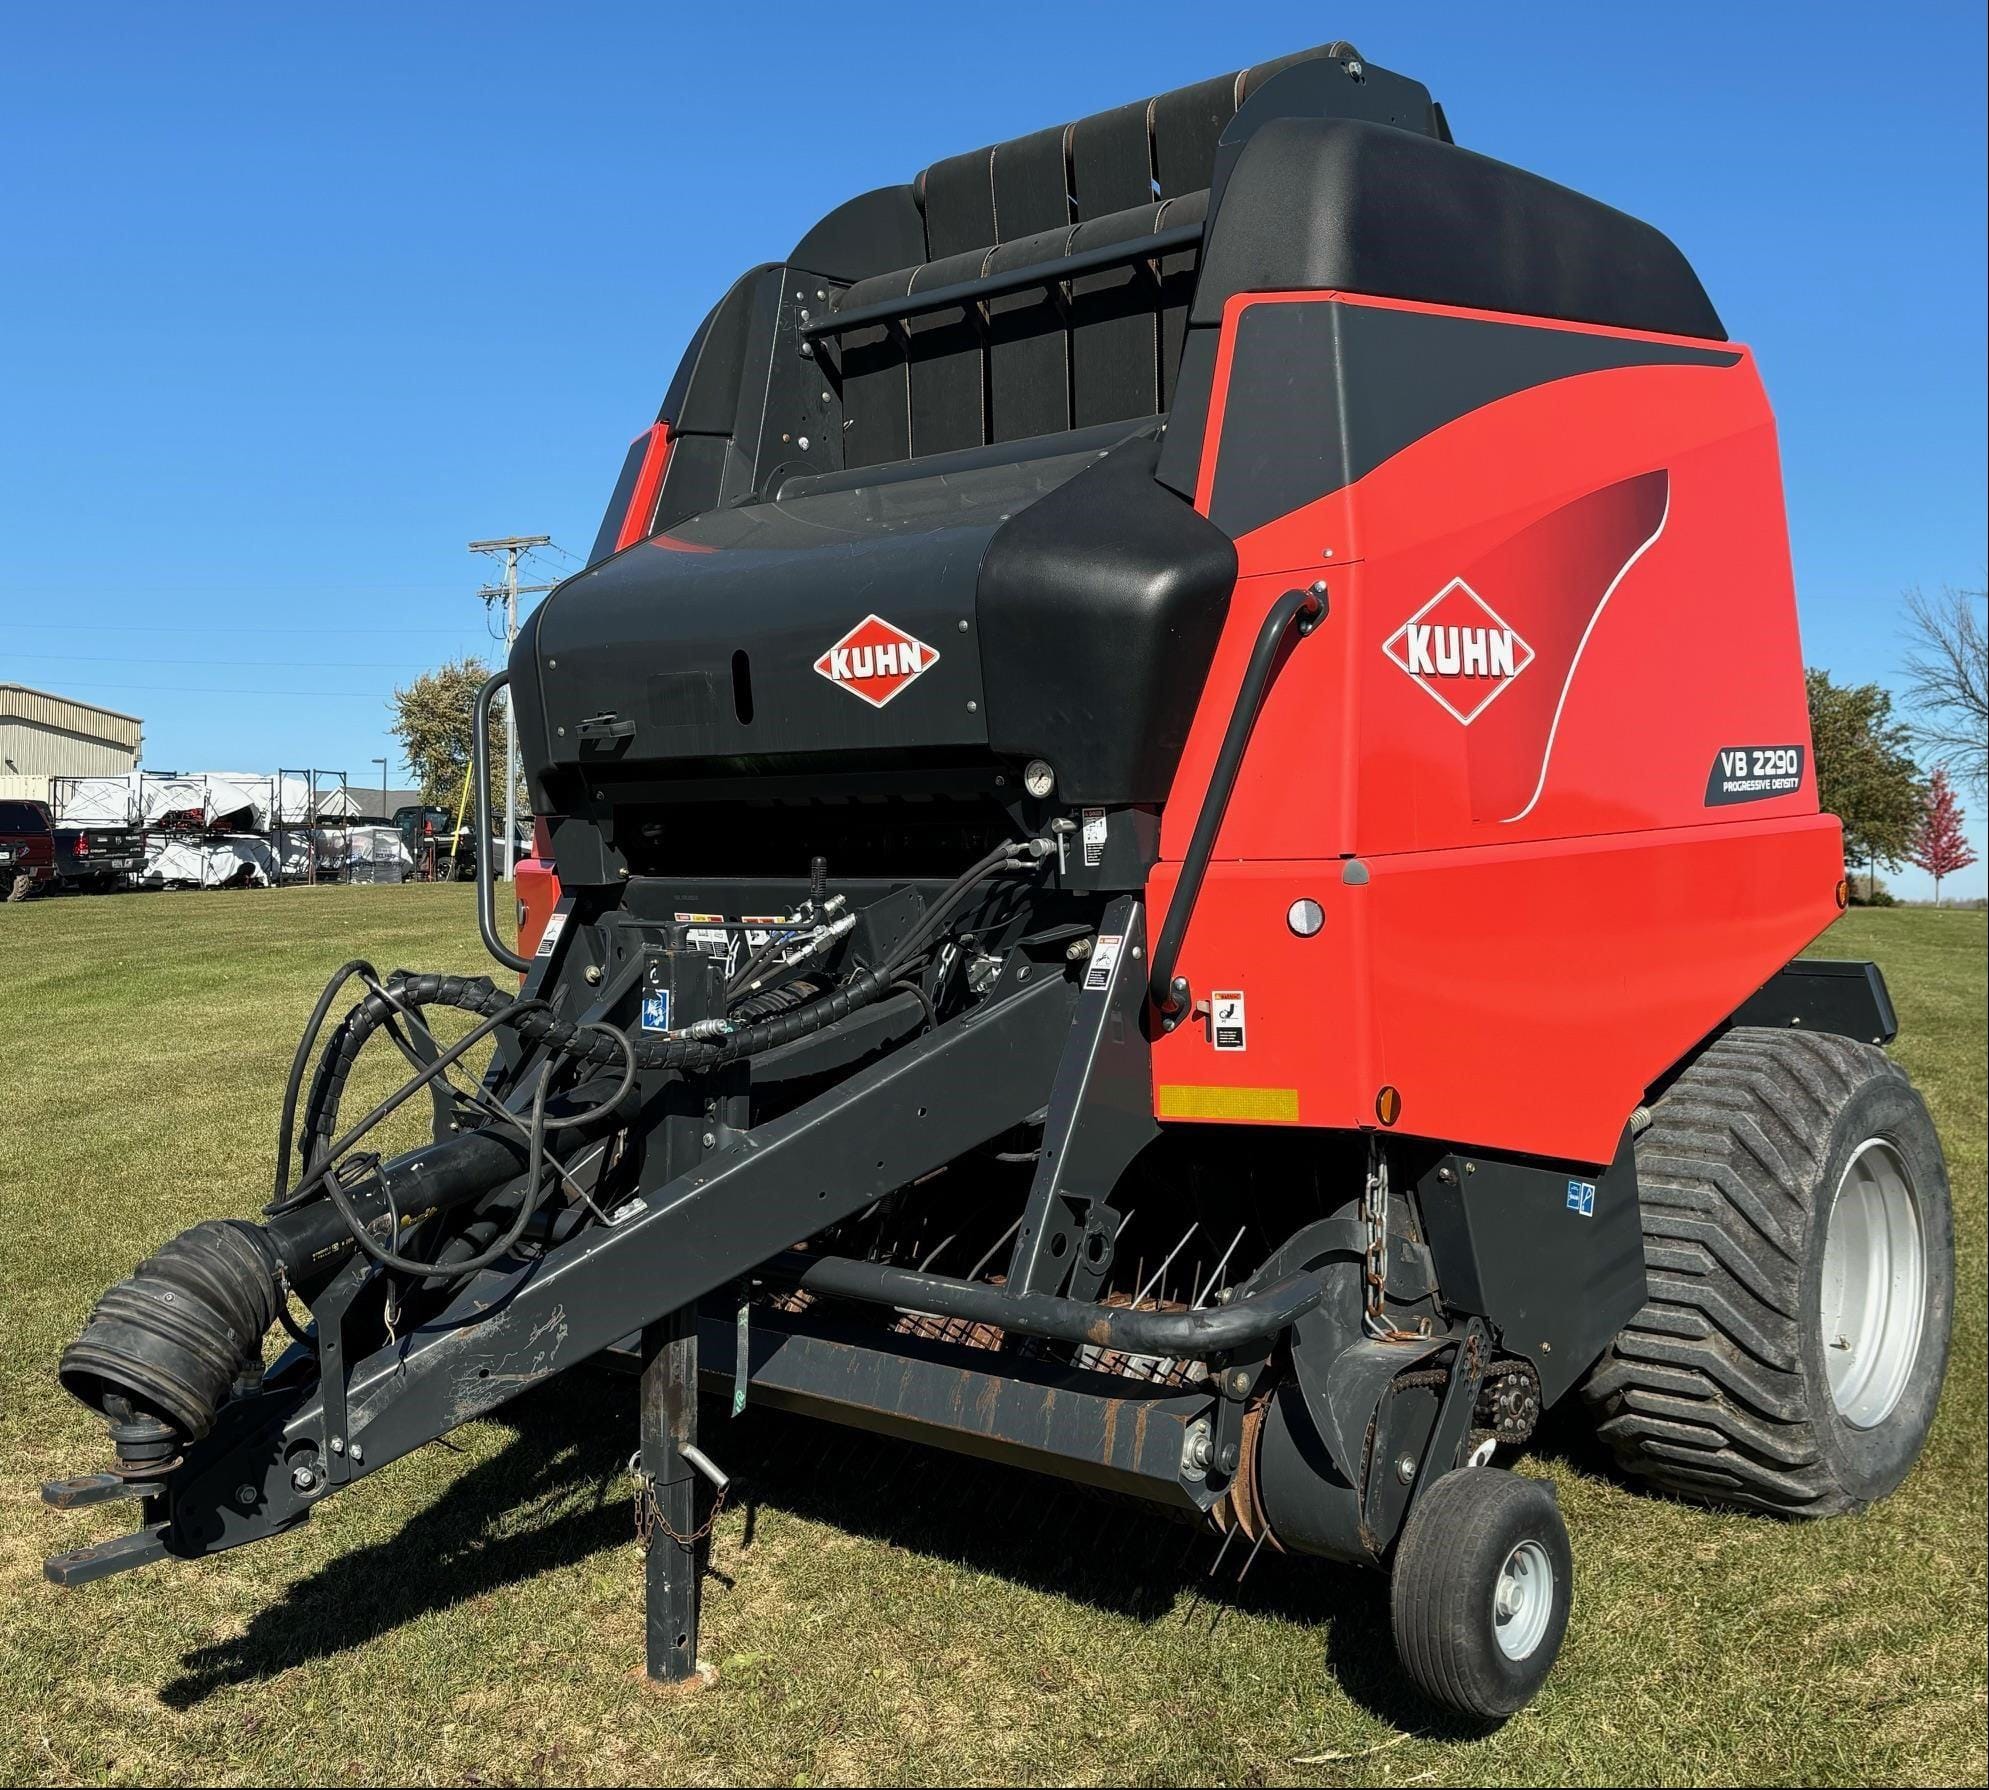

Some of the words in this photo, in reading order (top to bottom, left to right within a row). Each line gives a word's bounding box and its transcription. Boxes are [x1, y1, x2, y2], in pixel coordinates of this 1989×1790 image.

[830, 640, 922, 681] KUHN
[1406, 623, 1515, 679] KUHN
[1720, 751, 1748, 777] VB
[1752, 749, 1798, 776] 2290
[1723, 780, 1771, 792] PROGRESSIVE
[1772, 777, 1799, 789] DENSITY
